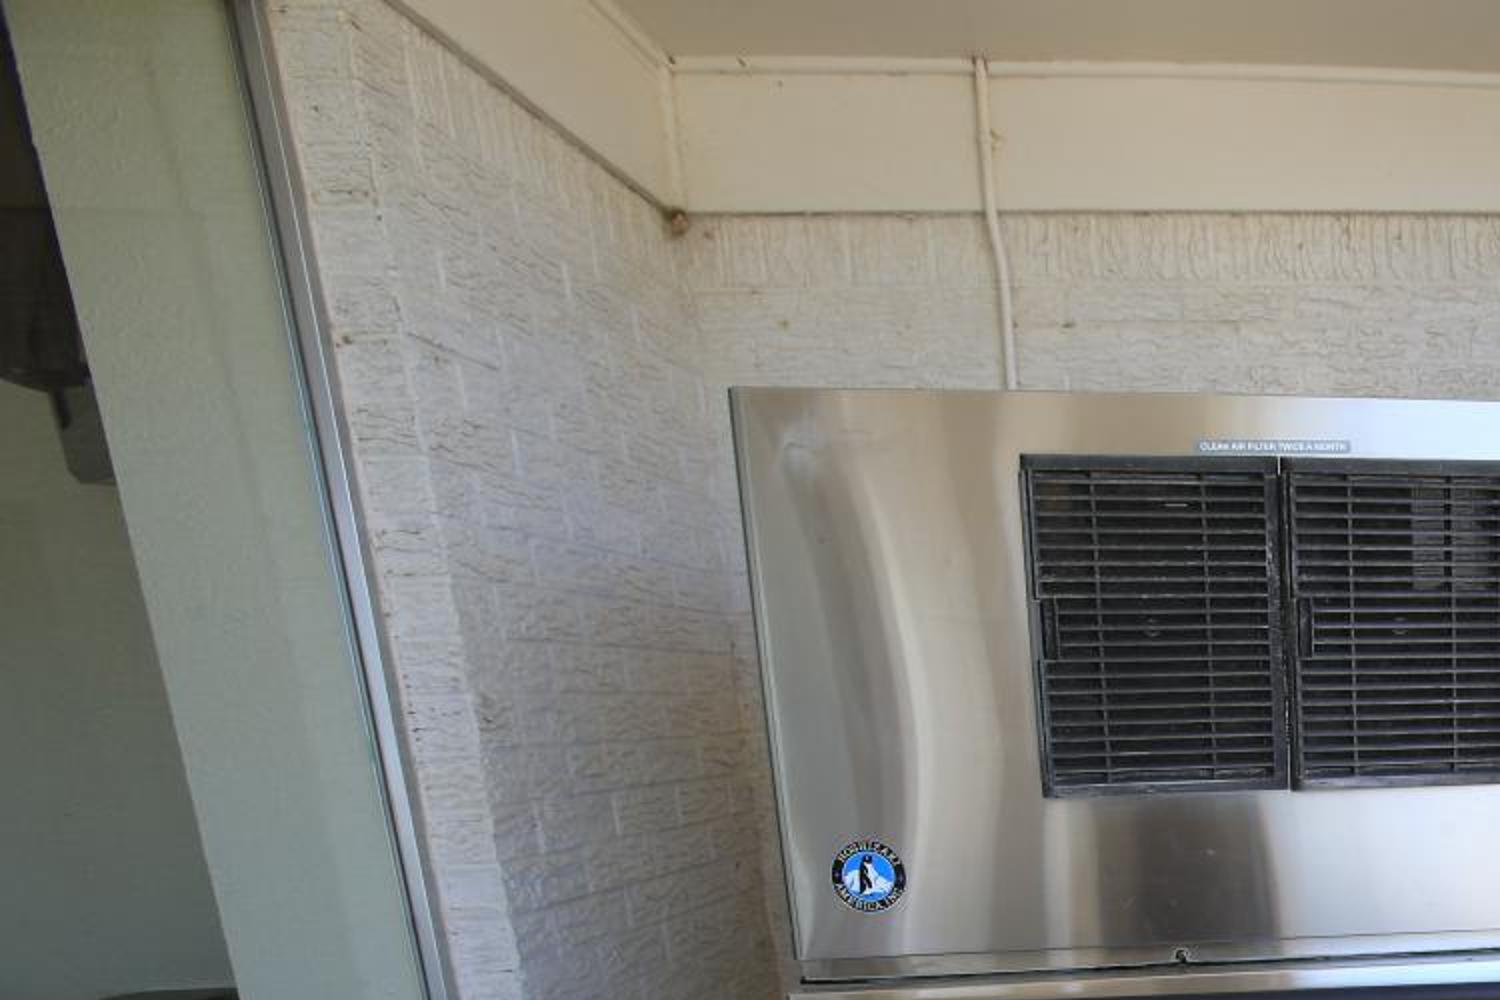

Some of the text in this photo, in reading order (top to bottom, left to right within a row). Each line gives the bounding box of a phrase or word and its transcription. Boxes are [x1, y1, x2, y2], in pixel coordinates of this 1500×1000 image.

[1200, 441, 1229, 451] CLEAN
[1231, 441, 1246, 451] AIR
[1248, 441, 1277, 451] FILTER
